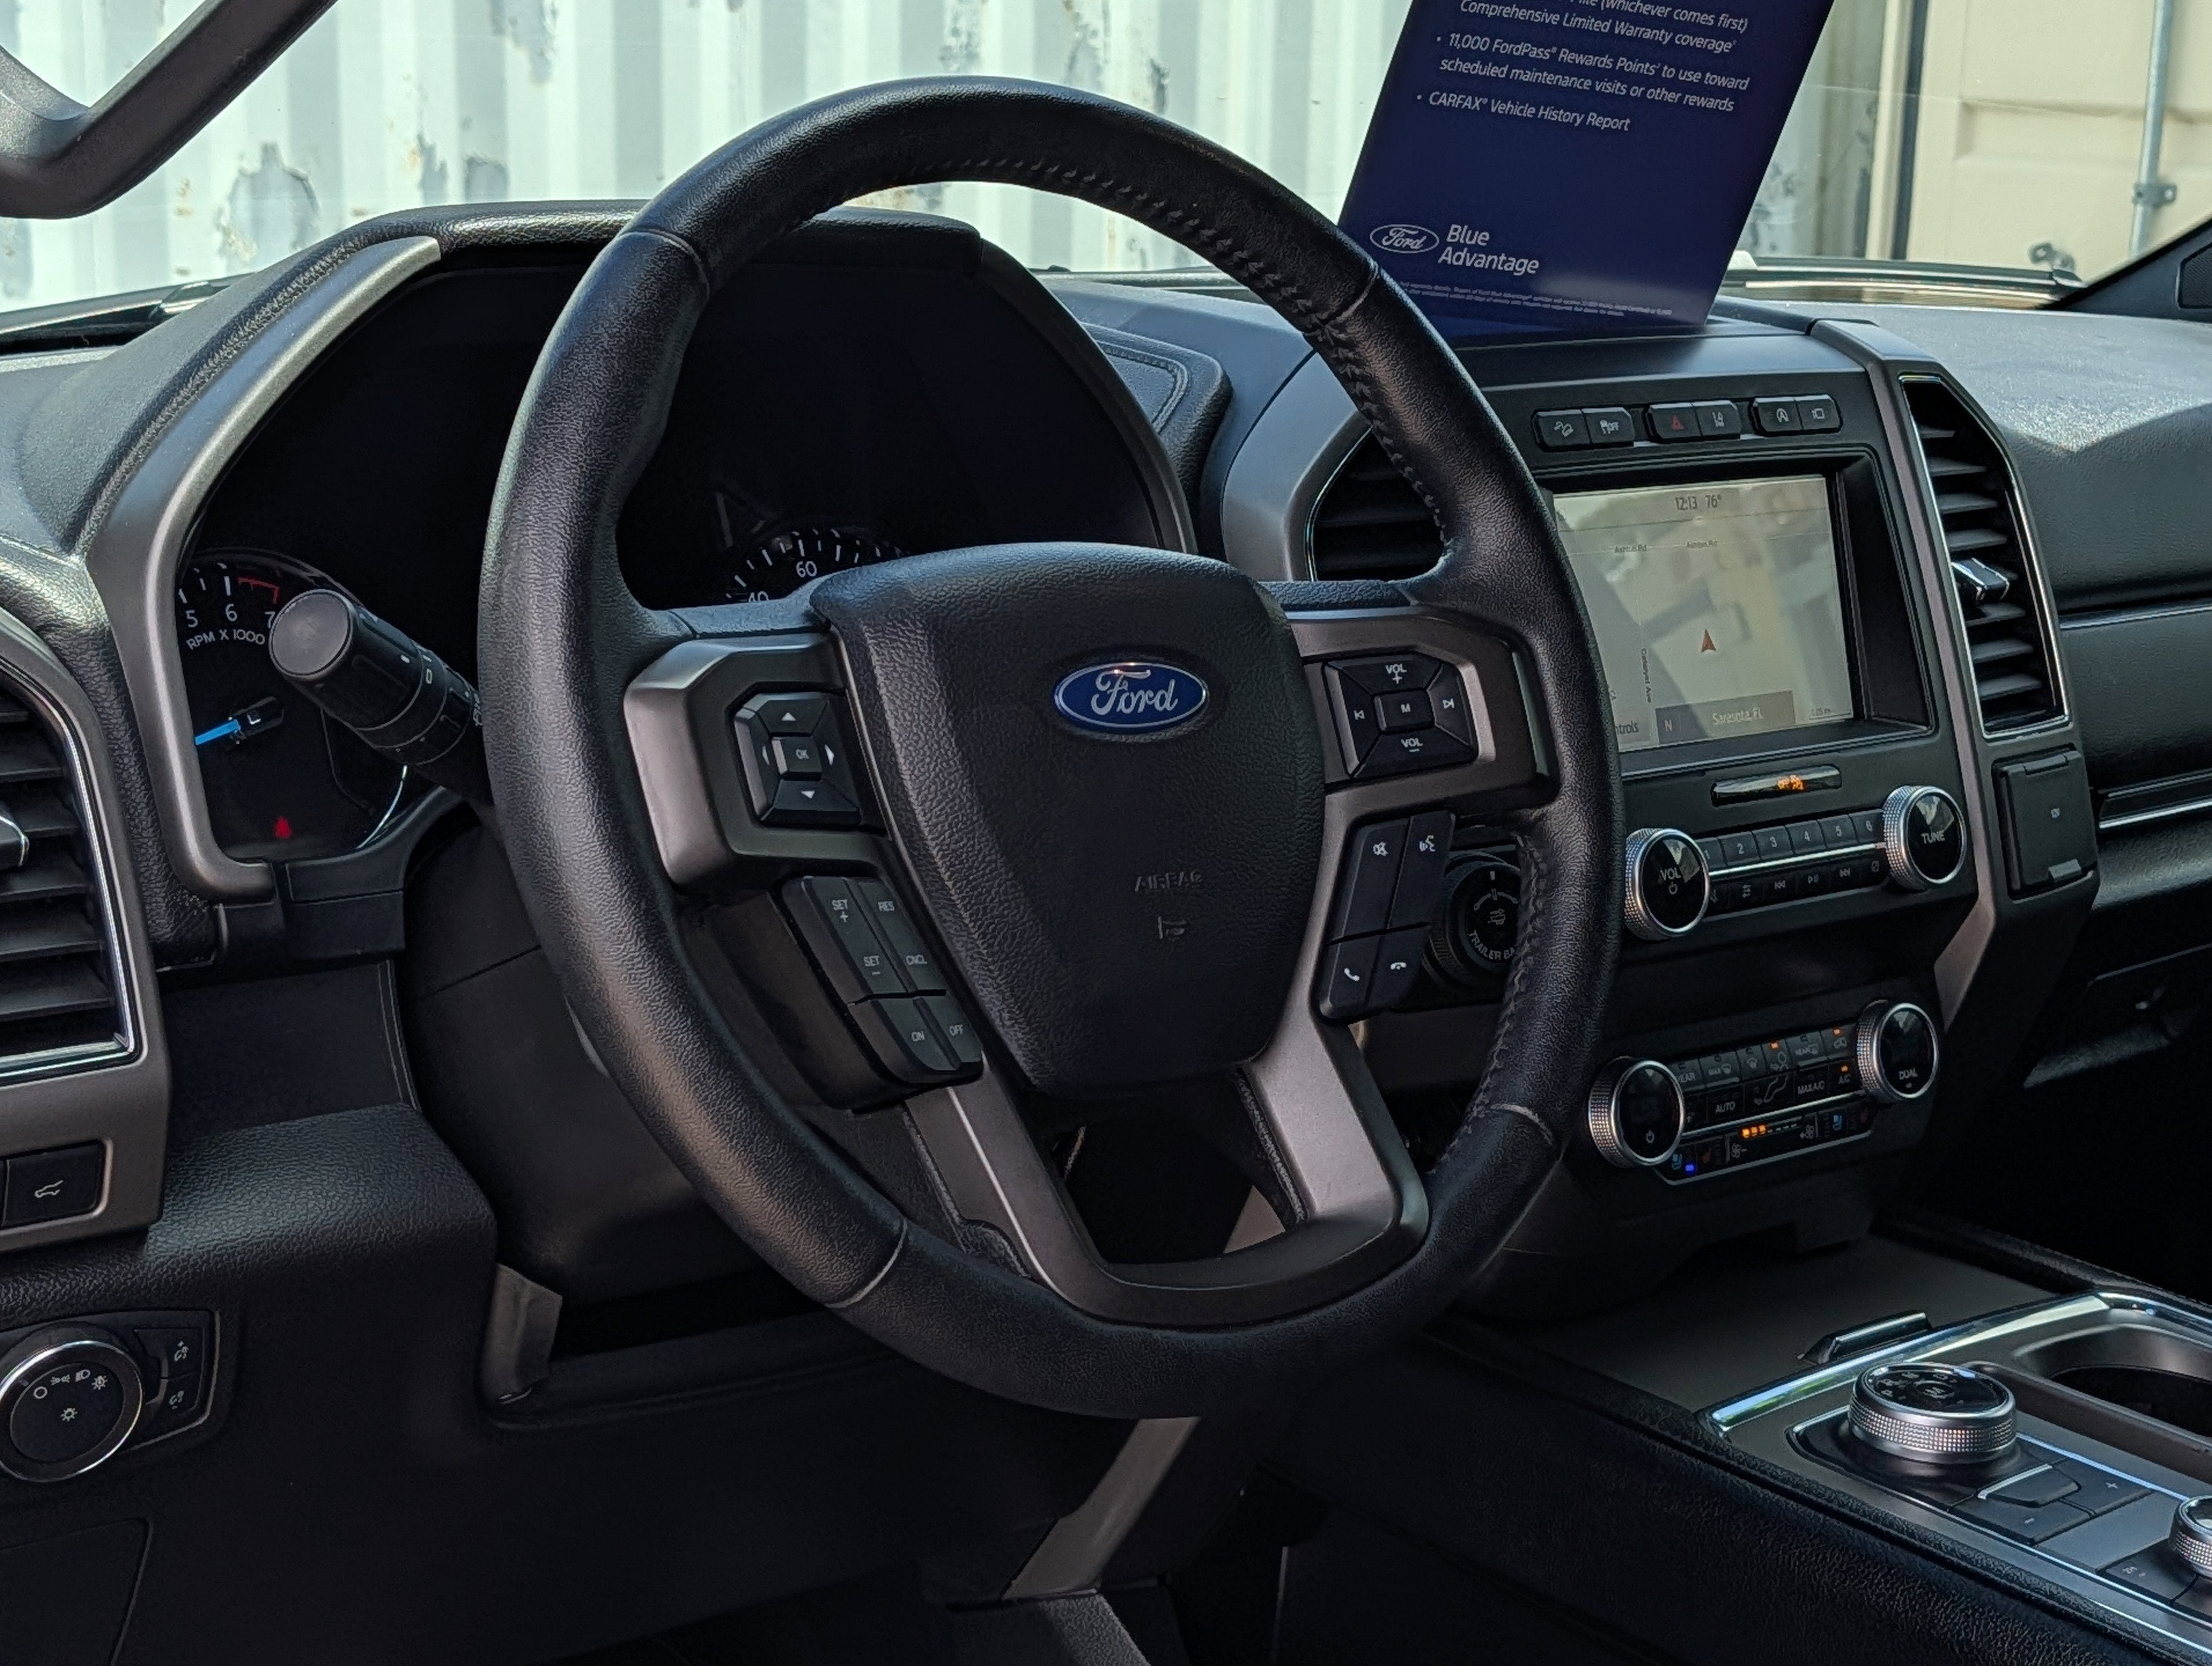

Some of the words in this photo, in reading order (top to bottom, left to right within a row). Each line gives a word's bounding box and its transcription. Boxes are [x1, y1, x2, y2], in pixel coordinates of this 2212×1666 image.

[1460, 0, 1560, 25] Comprehensive
[1562, 12, 1612, 33] Limited
[1614, 20, 1673, 45] Warranty
[1601, 0, 1672, 18] (whichever
[1673, 8, 1715, 26] comes
[1717, 13, 1748, 34] first)
[1449, 33, 1491, 51] 11,000
[1558, 48, 1613, 69] Rewards
[1662, 65, 1676, 78] to
[1679, 69, 1702, 83] use
[1704, 71, 1751, 91] toward
[1439, 57, 1509, 78] scheduled
[1509, 68, 1592, 89] maintenance
[1595, 78, 1628, 95] visits
[1629, 85, 1644, 98] or
[1646, 87, 1682, 104] other
[1683, 94, 1734, 112] rewards
[1490, 99, 1536, 118] Vehicle
[1538, 105, 1586, 126] History
[1586, 112, 1631, 131] Report
[1382, 227, 1427, 249] Ford
[1446, 224, 1490, 246] Blue
[1438, 246, 1540, 275] Advantage
[1675, 496, 1697, 510] 12:13
[796, 560, 818, 578] 60
[185, 610, 198, 627] 5
[225, 603, 238, 622] 6
[264, 611, 276, 629] 7
[185, 631, 216, 650] RPM
[233, 629, 266, 645] 1000
[1385, 663, 1407, 674] VOL
[1091, 669, 1179, 716] Ford
[1615, 720, 1639, 734] ntrols
[1401, 738, 1423, 748] VOL
[1737, 843, 1745, 855] 2
[1769, 836, 1778, 848] 3
[1804, 830, 1810, 841] 4
[1835, 825, 1842, 836] 5
[1866, 819, 1873, 831] 6
[1921, 830, 1945, 844] TUNE
[1660, 867, 1682, 881] VOL
[832, 899, 848, 911] SET
[864, 956, 880, 967] SET
[911, 1031, 925, 1042] ON
[949, 1024, 963, 1036] OFF
[1899, 1067, 1918, 1080] DUAL
[1715, 1101, 1735, 1114] AUTO
